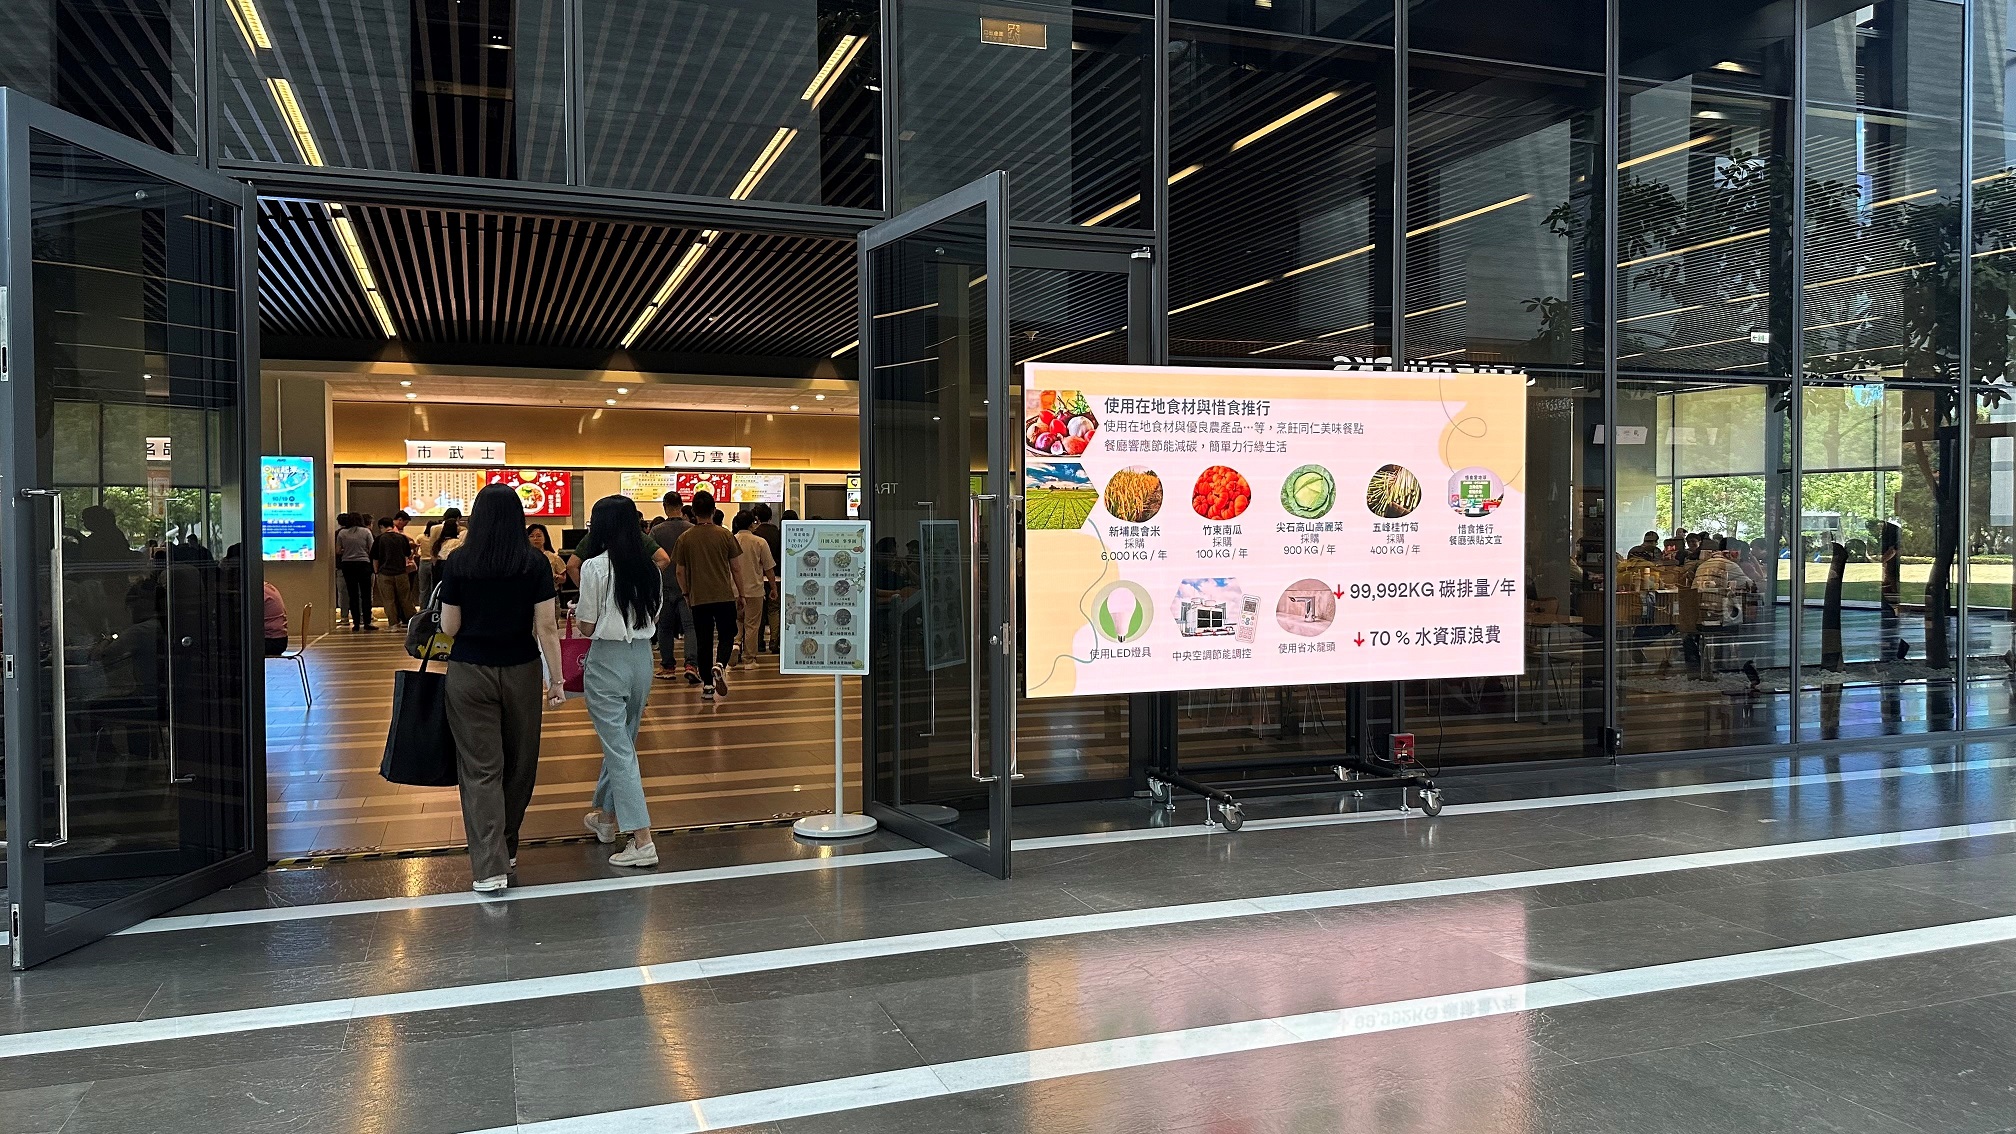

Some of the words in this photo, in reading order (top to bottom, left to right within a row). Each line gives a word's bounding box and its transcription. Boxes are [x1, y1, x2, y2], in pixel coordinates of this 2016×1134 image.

[1104, 397, 1270, 416] 使用在地食材與惜食推行
[1104, 439, 1287, 453] 餐廳響應節能減碳，簡單力行綠生活
[417, 446, 495, 460] 市武士
[675, 450, 741, 464] 八方雲集
[1108, 526, 1160, 537] 新埔農會米
[1202, 524, 1242, 536] 竹東南瓜
[1276, 522, 1344, 532] 尖石高山高麗菜
[1373, 522, 1419, 533] 五峰桂竹筍
[1458, 524, 1494, 534] 惜食推行
[1125, 538, 1145, 549] 採購
[1213, 536, 1232, 548] 採購
[1300, 533, 1320, 544] 採購
[1386, 534, 1405, 544] 採購
[1450, 535, 1502, 546] 餐廳張貼文宣
[1196, 550, 1214, 558] 100
[1216, 549, 1230, 558] KG
[1238, 548, 1248, 558] 年
[1284, 546, 1302, 554] 900
[1304, 546, 1318, 554] KG
[1326, 544, 1336, 555] 年
[1370, 546, 1388, 554] 400
[1390, 546, 1404, 554] KG
[1412, 544, 1420, 554] 年
[1101, 550, 1130, 562] 6,000
[1132, 551, 1148, 560] KG
[1158, 550, 1168, 560] 年
[1350, 582, 1434, 601] 99,992KG
[1438, 578, 1516, 598] 碳排量/年
[1370, 631, 1391, 646] 70
[1396, 630, 1410, 646] %
[1414, 624, 1501, 646] 水資源浪費
[1090, 647, 1152, 660] 使用LED燈具
[1278, 641, 1336, 654] 使用省水龍頭
[1172, 648, 1252, 662] 中央空調節能調控
